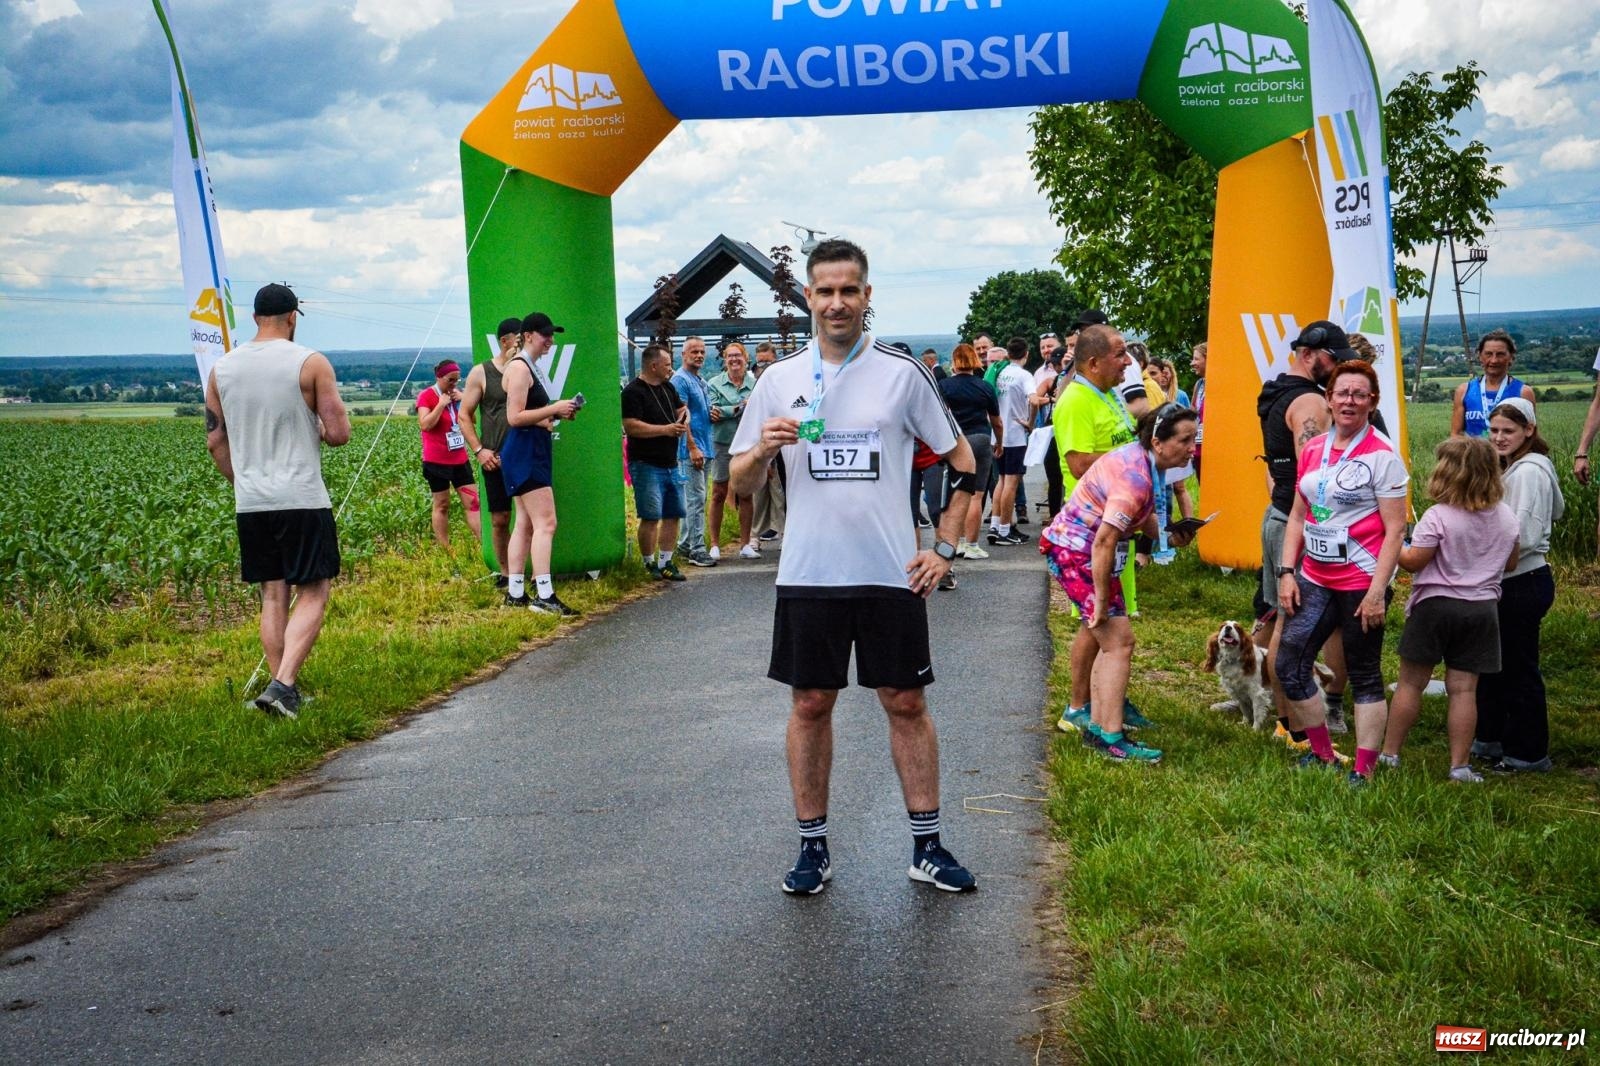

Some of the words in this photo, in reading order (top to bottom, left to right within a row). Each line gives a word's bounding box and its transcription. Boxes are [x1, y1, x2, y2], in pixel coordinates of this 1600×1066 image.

[717, 30, 1071, 92] RACIBORSKI
[1178, 82, 1226, 97] powiat
[1234, 77, 1305, 93] raciborski
[1181, 98, 1220, 106] zielona
[1228, 97, 1259, 106] oaza
[1267, 93, 1305, 103] kultur
[514, 115, 556, 131] powiat
[563, 112, 626, 128] raciborski
[514, 131, 551, 140] zielona
[558, 130, 586, 139] oaza
[593, 127, 625, 138] kultur
[823, 449, 858, 466] 157
[1310, 537, 1329, 553] 115
